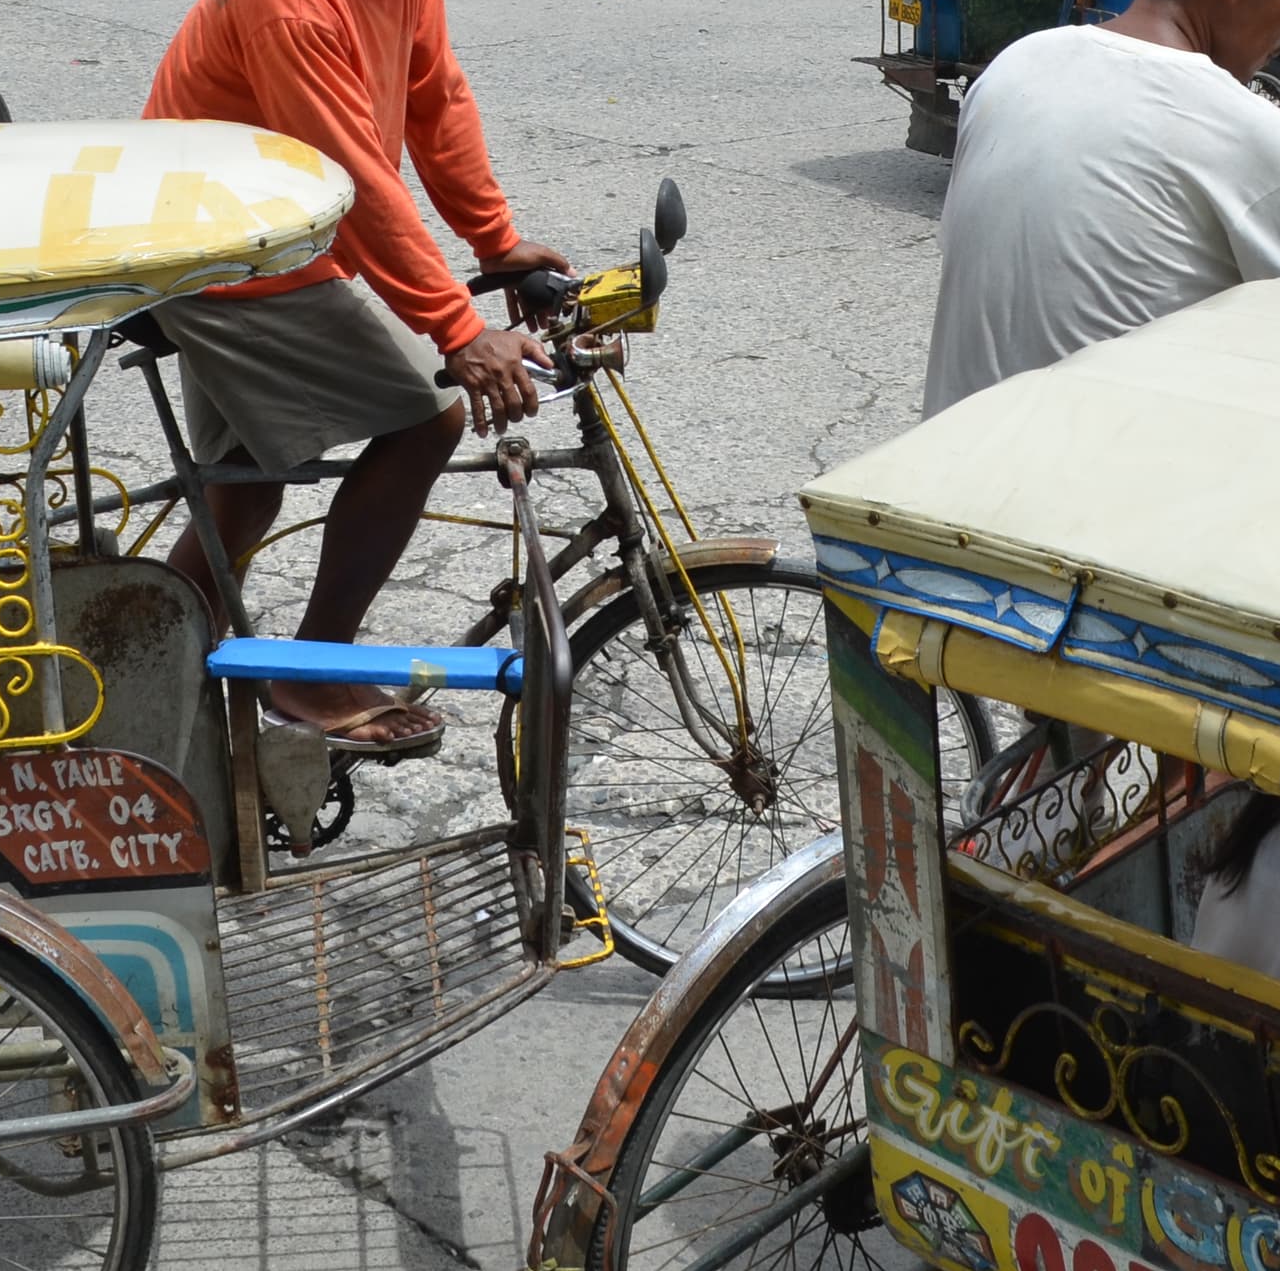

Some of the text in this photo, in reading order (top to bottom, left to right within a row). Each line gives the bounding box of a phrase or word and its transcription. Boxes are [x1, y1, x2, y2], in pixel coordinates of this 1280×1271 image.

[11, 760, 49, 794] N.
[108, 792, 157, 826] 04
[110, 830, 183, 870] CITY
[878, 1046, 1063, 1193] Gift
[1076, 1134, 1138, 1226] of
